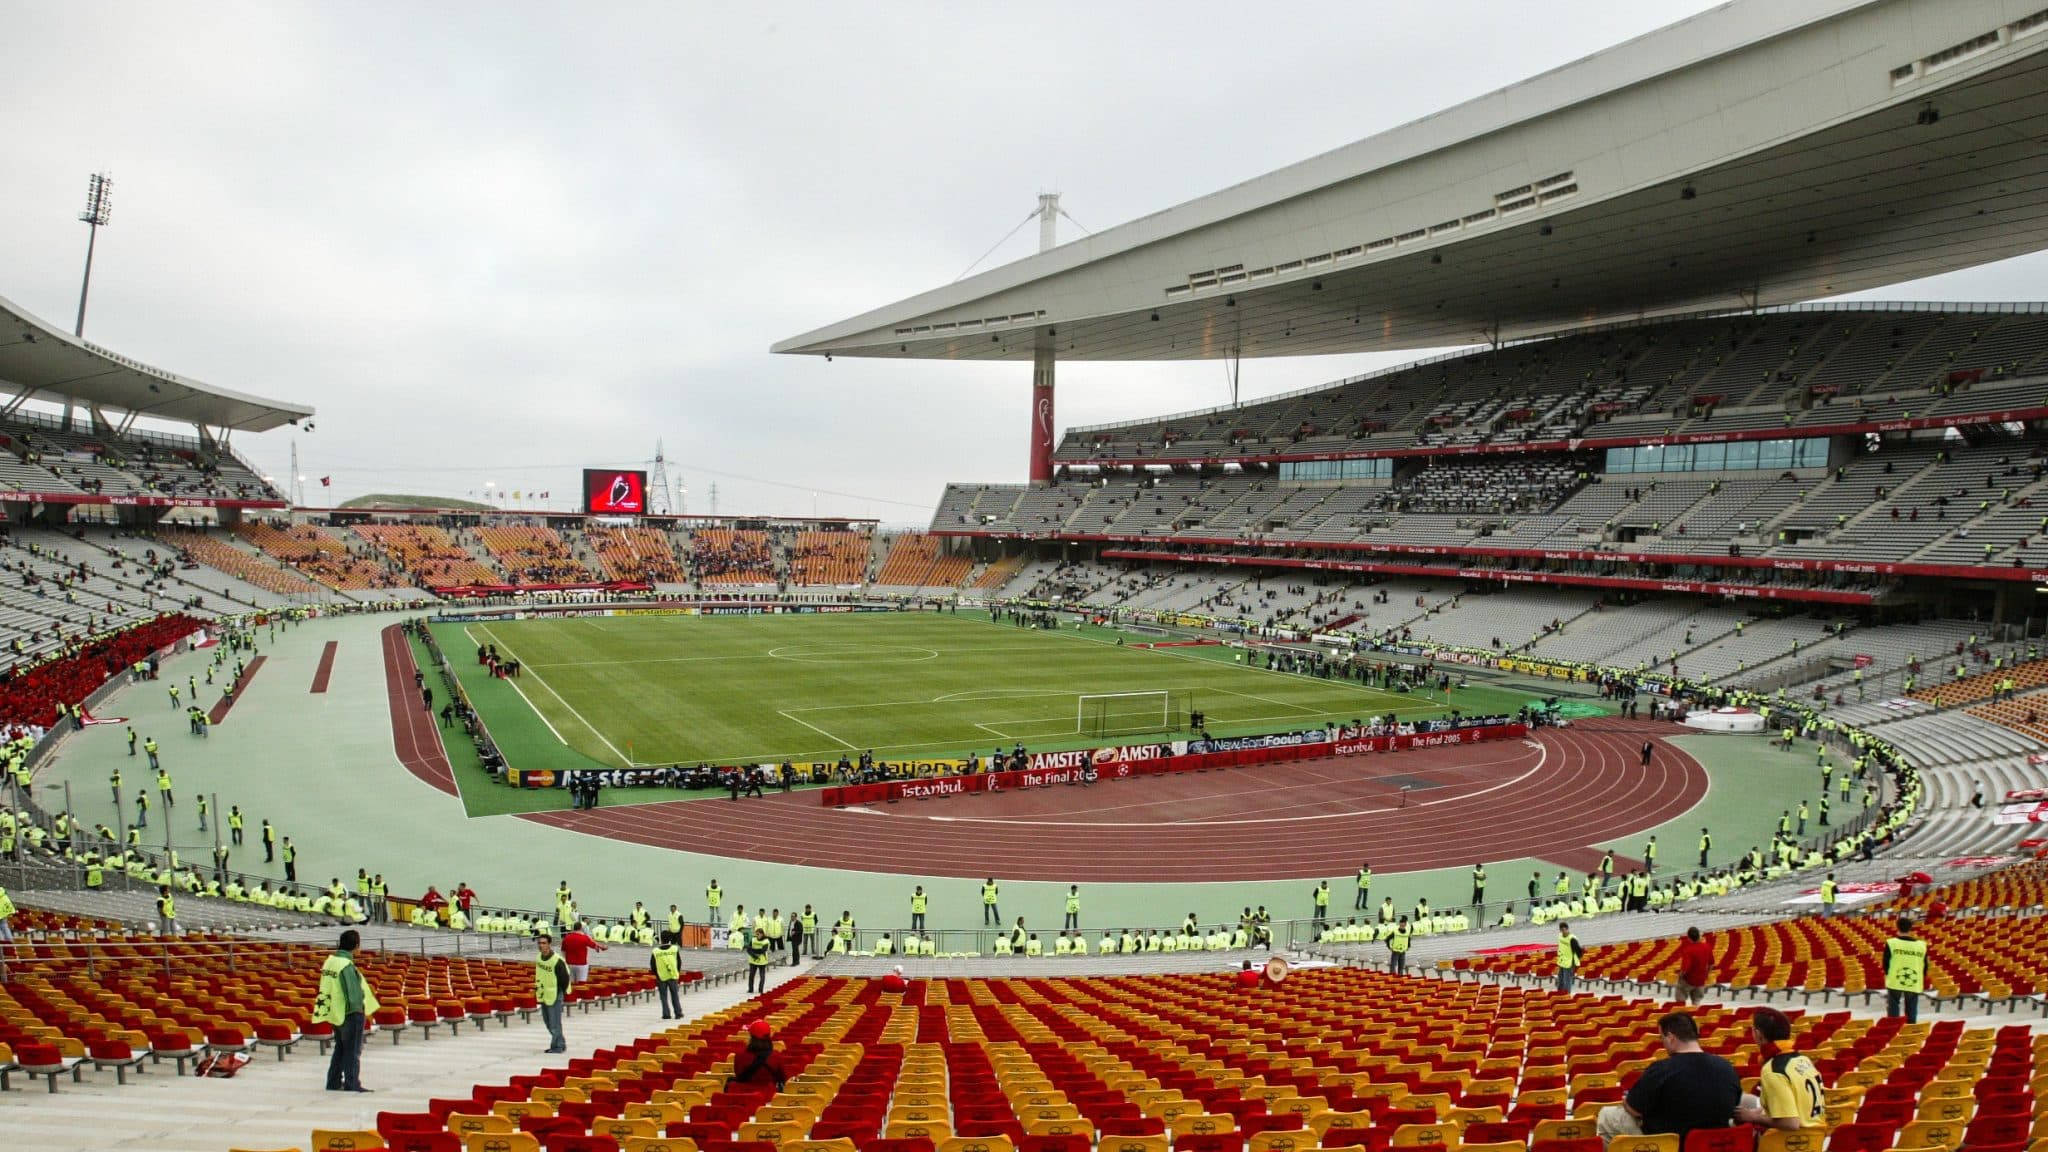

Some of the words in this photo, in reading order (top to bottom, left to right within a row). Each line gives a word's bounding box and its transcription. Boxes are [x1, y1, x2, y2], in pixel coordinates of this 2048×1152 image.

[538, 611, 563, 619] AMSTEL
[713, 607, 762, 615] MasterCard
[1412, 737, 1424, 747] The
[1426, 735, 1442, 746] Final
[1444, 734, 1461, 743] 2005
[1023, 773, 1042, 786] The
[1045, 771, 1069, 785] Final
[1072, 769, 1098, 784] 205
